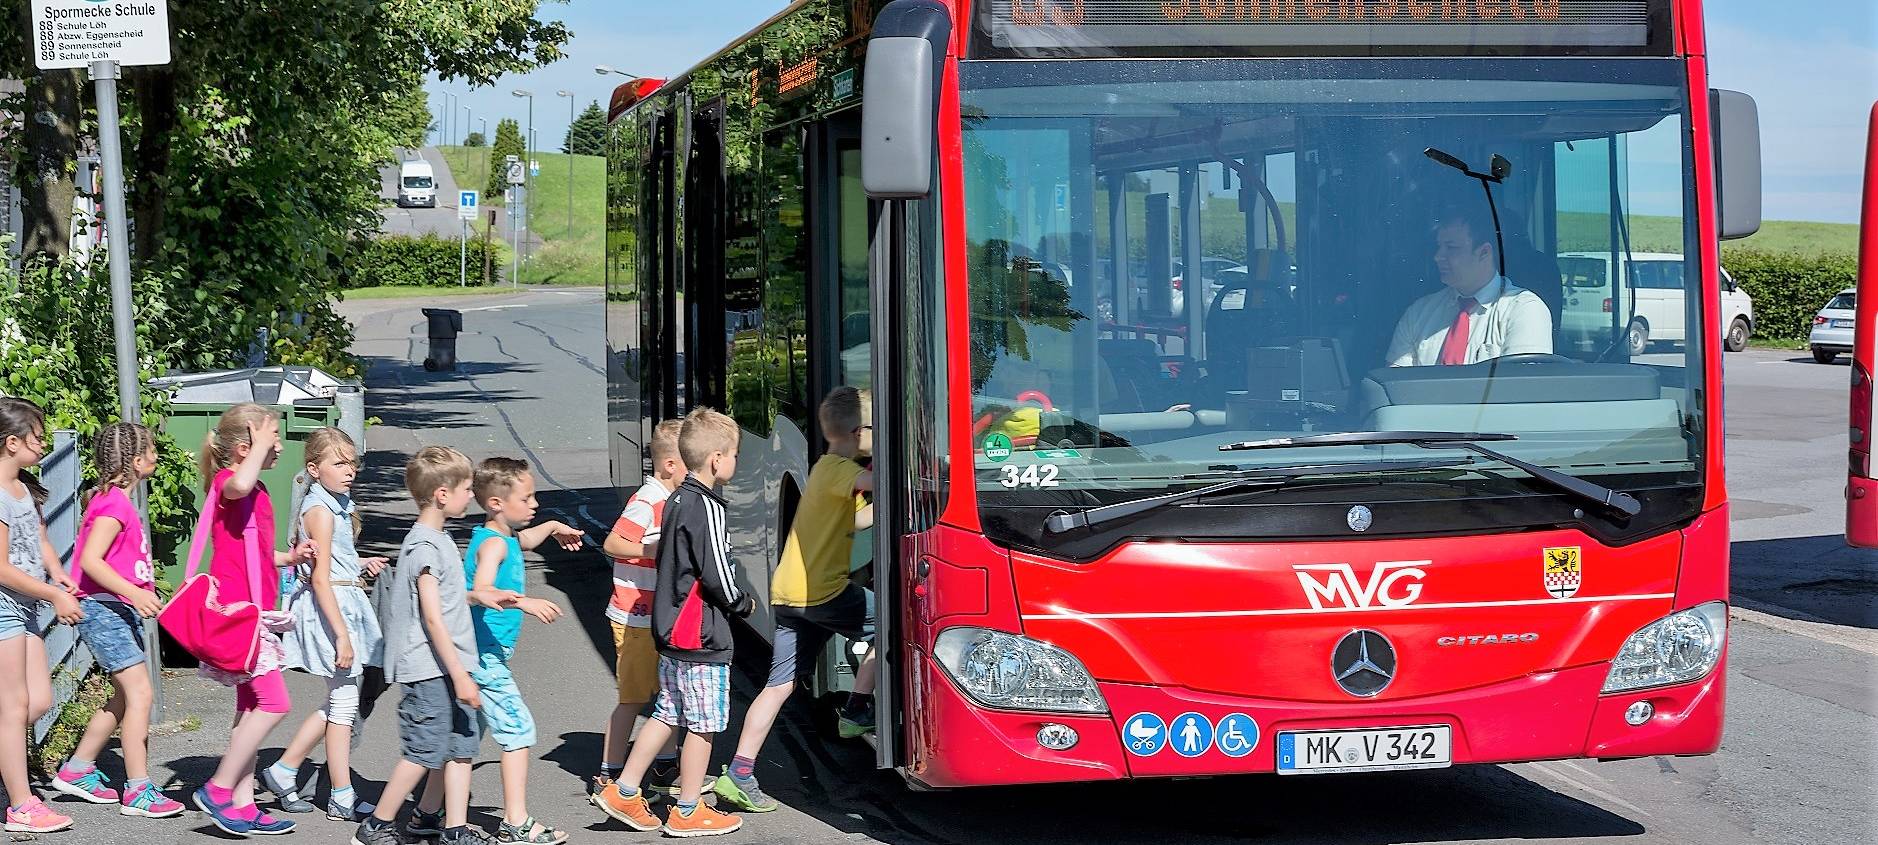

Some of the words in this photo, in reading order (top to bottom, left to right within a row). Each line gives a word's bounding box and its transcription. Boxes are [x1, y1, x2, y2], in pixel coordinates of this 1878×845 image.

[44, 4, 111, 21] Spormecke
[115, 3, 156, 16] Schule
[39, 20, 54, 30] 88
[57, 21, 88, 30] Schule
[89, 21, 107, 29] Löh
[40, 31, 54, 40] 88
[57, 31, 84, 40] Abzw.
[86, 29, 144, 40] Eggenscheid
[40, 41, 55, 51] 89
[58, 41, 122, 50] Sonnenscheid
[41, 51, 56, 61] 89
[59, 52, 90, 60] Schule
[92, 51, 109, 59] Löh
[993, 435, 1002, 448] 4
[1000, 464, 1060, 488] 342
[1292, 560, 1433, 610] MVG
[1436, 632, 1540, 647] CITARO
[1283, 755, 1291, 764] D
[1306, 736, 1342, 764] MK
[1362, 734, 1379, 762] V
[1386, 732, 1436, 761] 342
